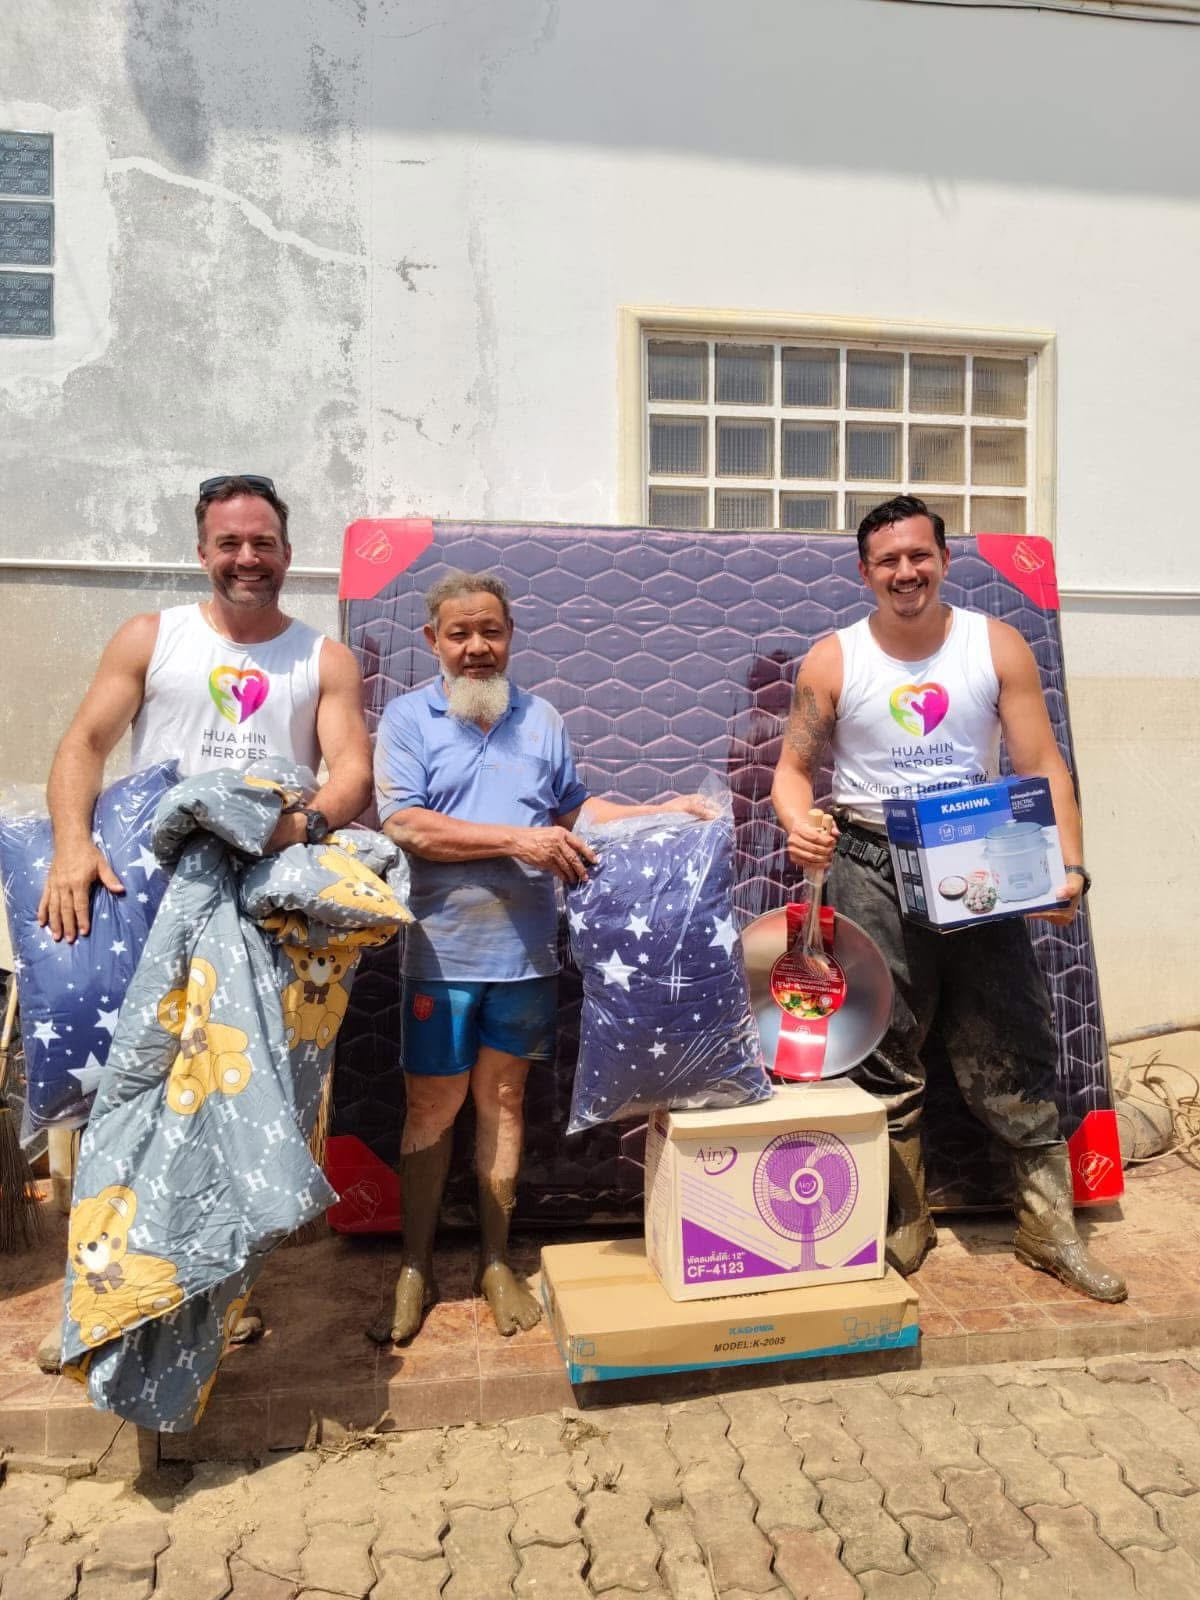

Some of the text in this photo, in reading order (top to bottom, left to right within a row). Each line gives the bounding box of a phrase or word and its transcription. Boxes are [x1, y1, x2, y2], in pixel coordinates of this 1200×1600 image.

[203, 728, 267, 745] HUA HIN
[201, 744, 268, 759] HEROES
[891, 741, 954, 758] HUA HIN
[940, 797, 991, 815] KASHIWA
[694, 1146, 728, 1165] Airy
[687, 1261, 745, 1278] CF-4123
